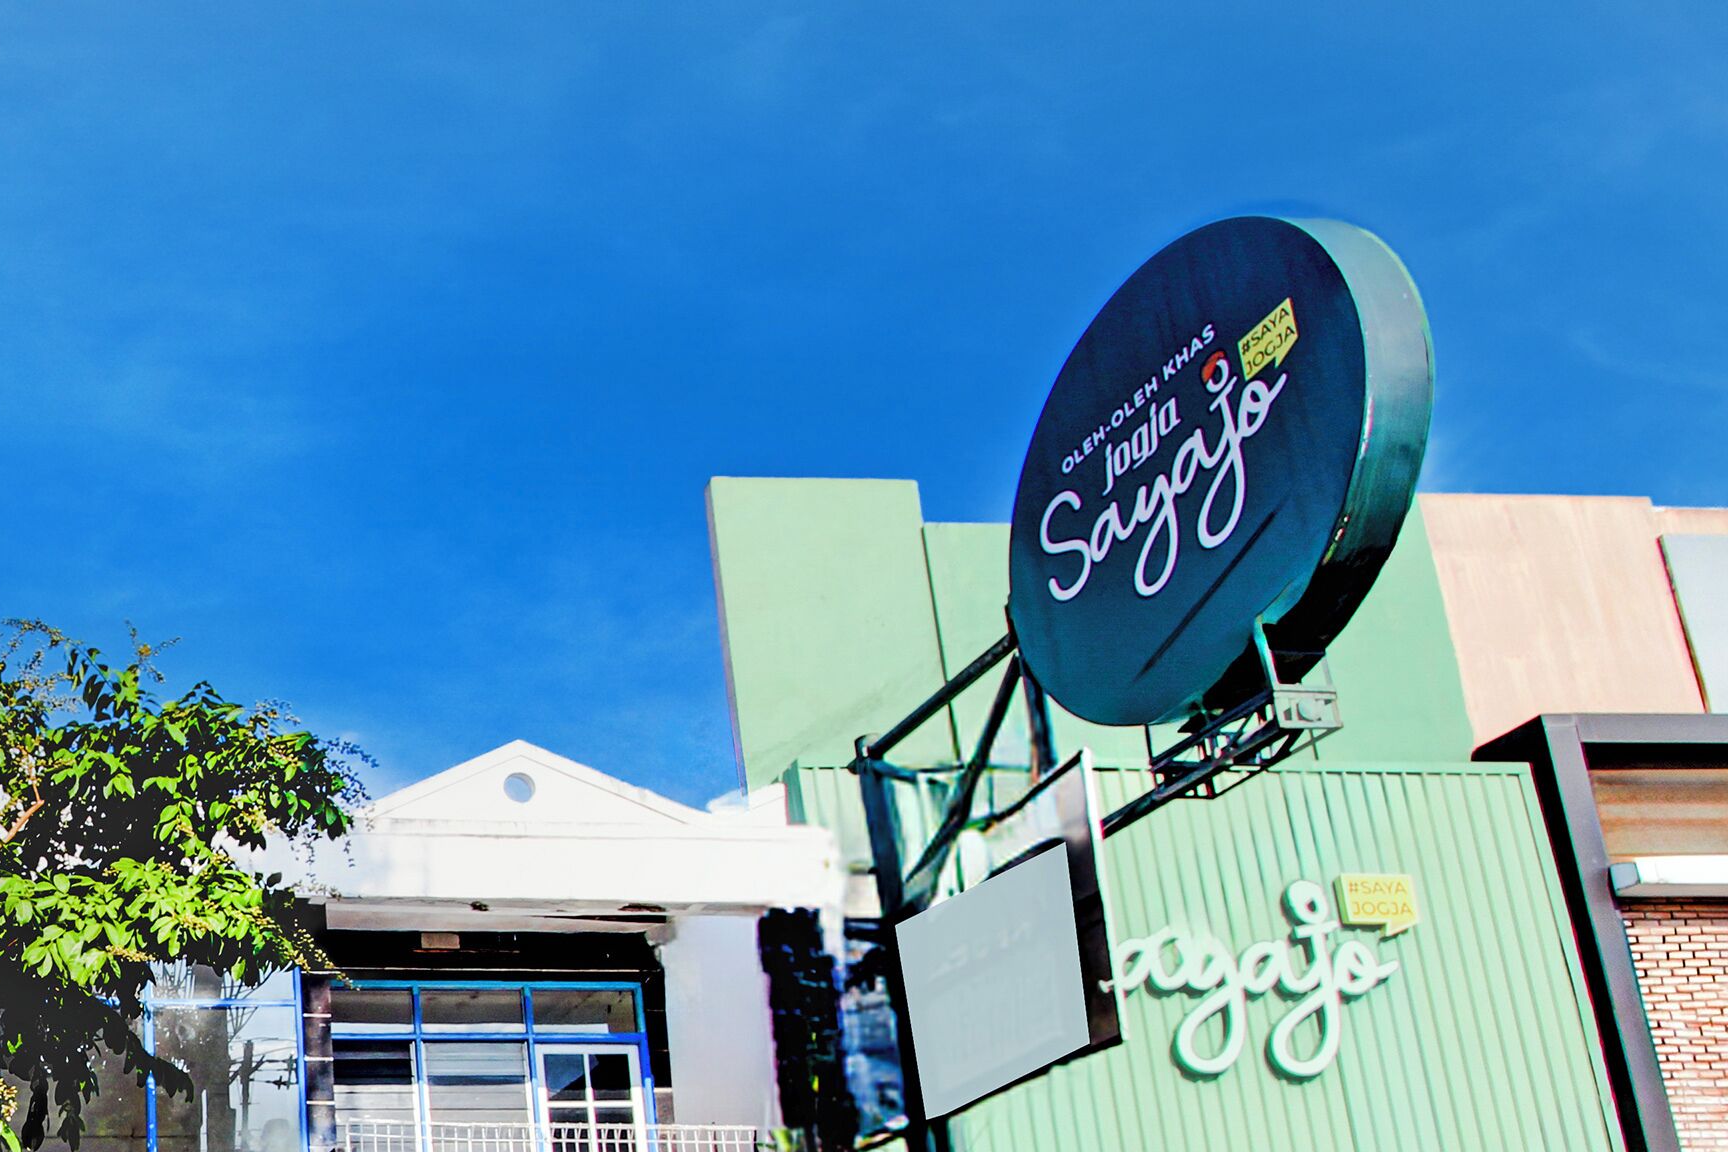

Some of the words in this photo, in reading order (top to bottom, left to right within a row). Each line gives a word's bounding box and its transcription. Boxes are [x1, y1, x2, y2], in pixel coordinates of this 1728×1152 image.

[1242, 308, 1290, 355] #SAYA
[1246, 326, 1295, 376] JOGJA
[1061, 376, 1159, 475] OLEH-OLEH
[1162, 323, 1216, 382] KHAS
[1349, 880, 1408, 895] #SAYA
[1353, 901, 1414, 916] JOGJA
